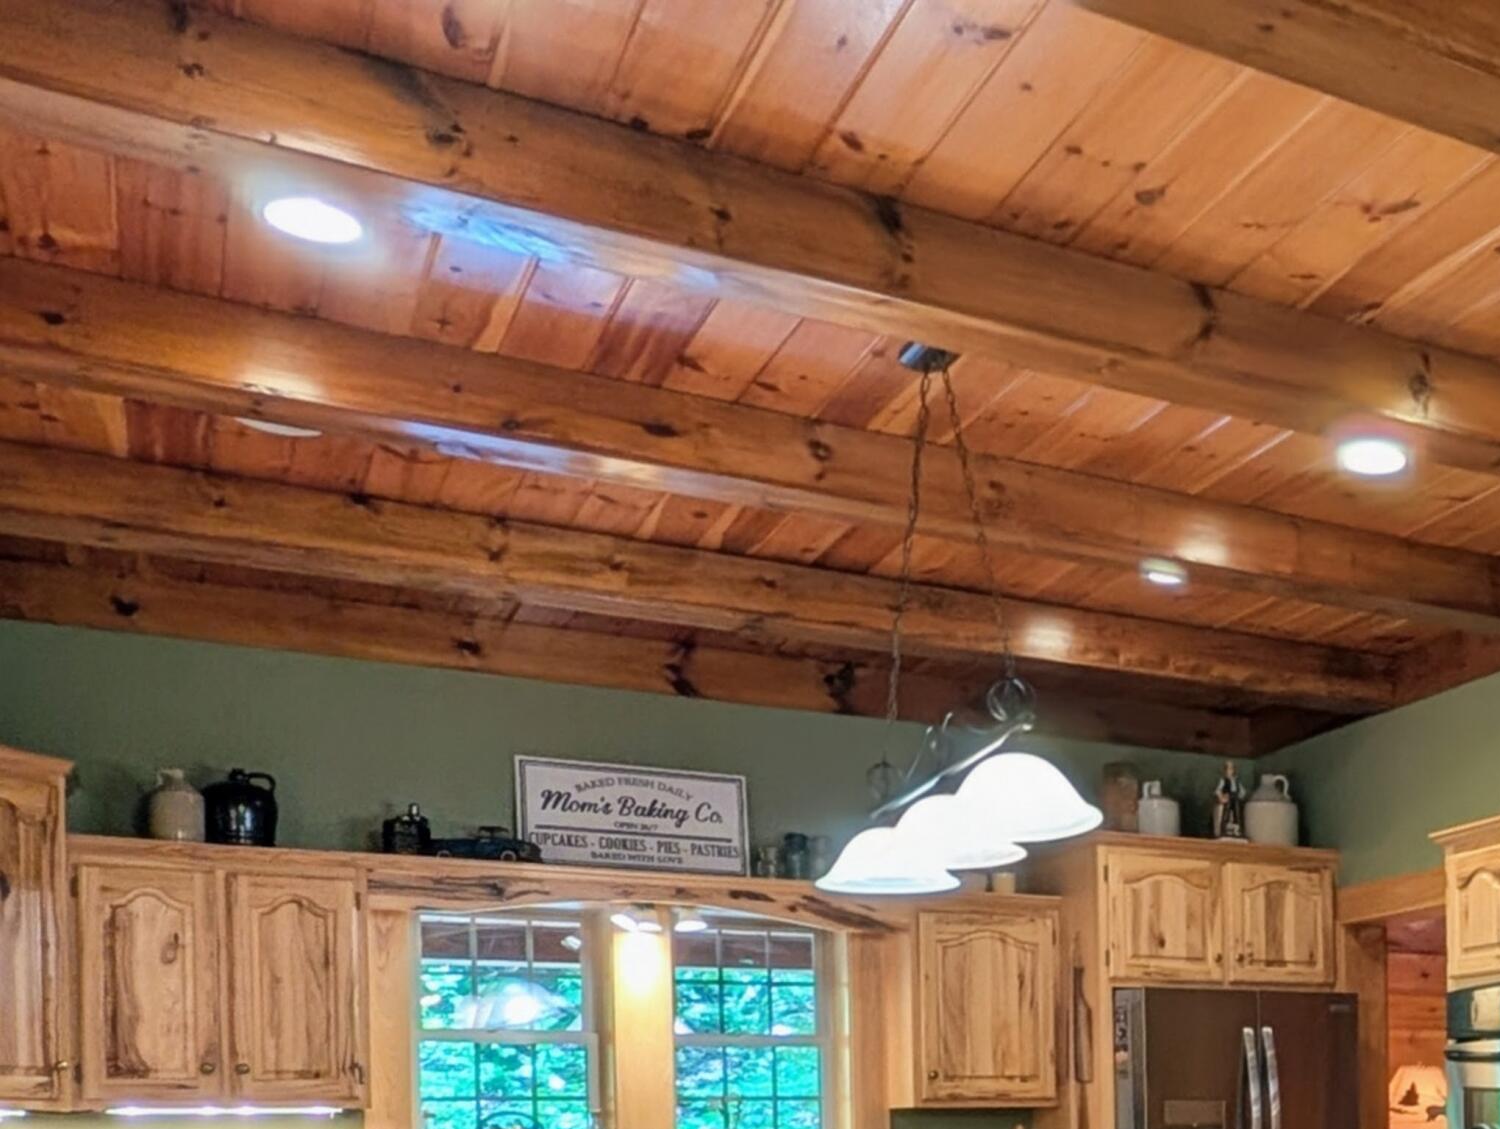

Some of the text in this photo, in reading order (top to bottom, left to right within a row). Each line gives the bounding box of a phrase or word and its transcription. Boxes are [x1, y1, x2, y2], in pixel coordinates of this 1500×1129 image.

[575, 777, 693, 801] BAKED FRESH DAILY
[540, 788, 613, 815] Mom's
[617, 795, 690, 829] Baking
[529, 832, 740, 859] CUPCAKES COOKIES PIES PASTRIES
